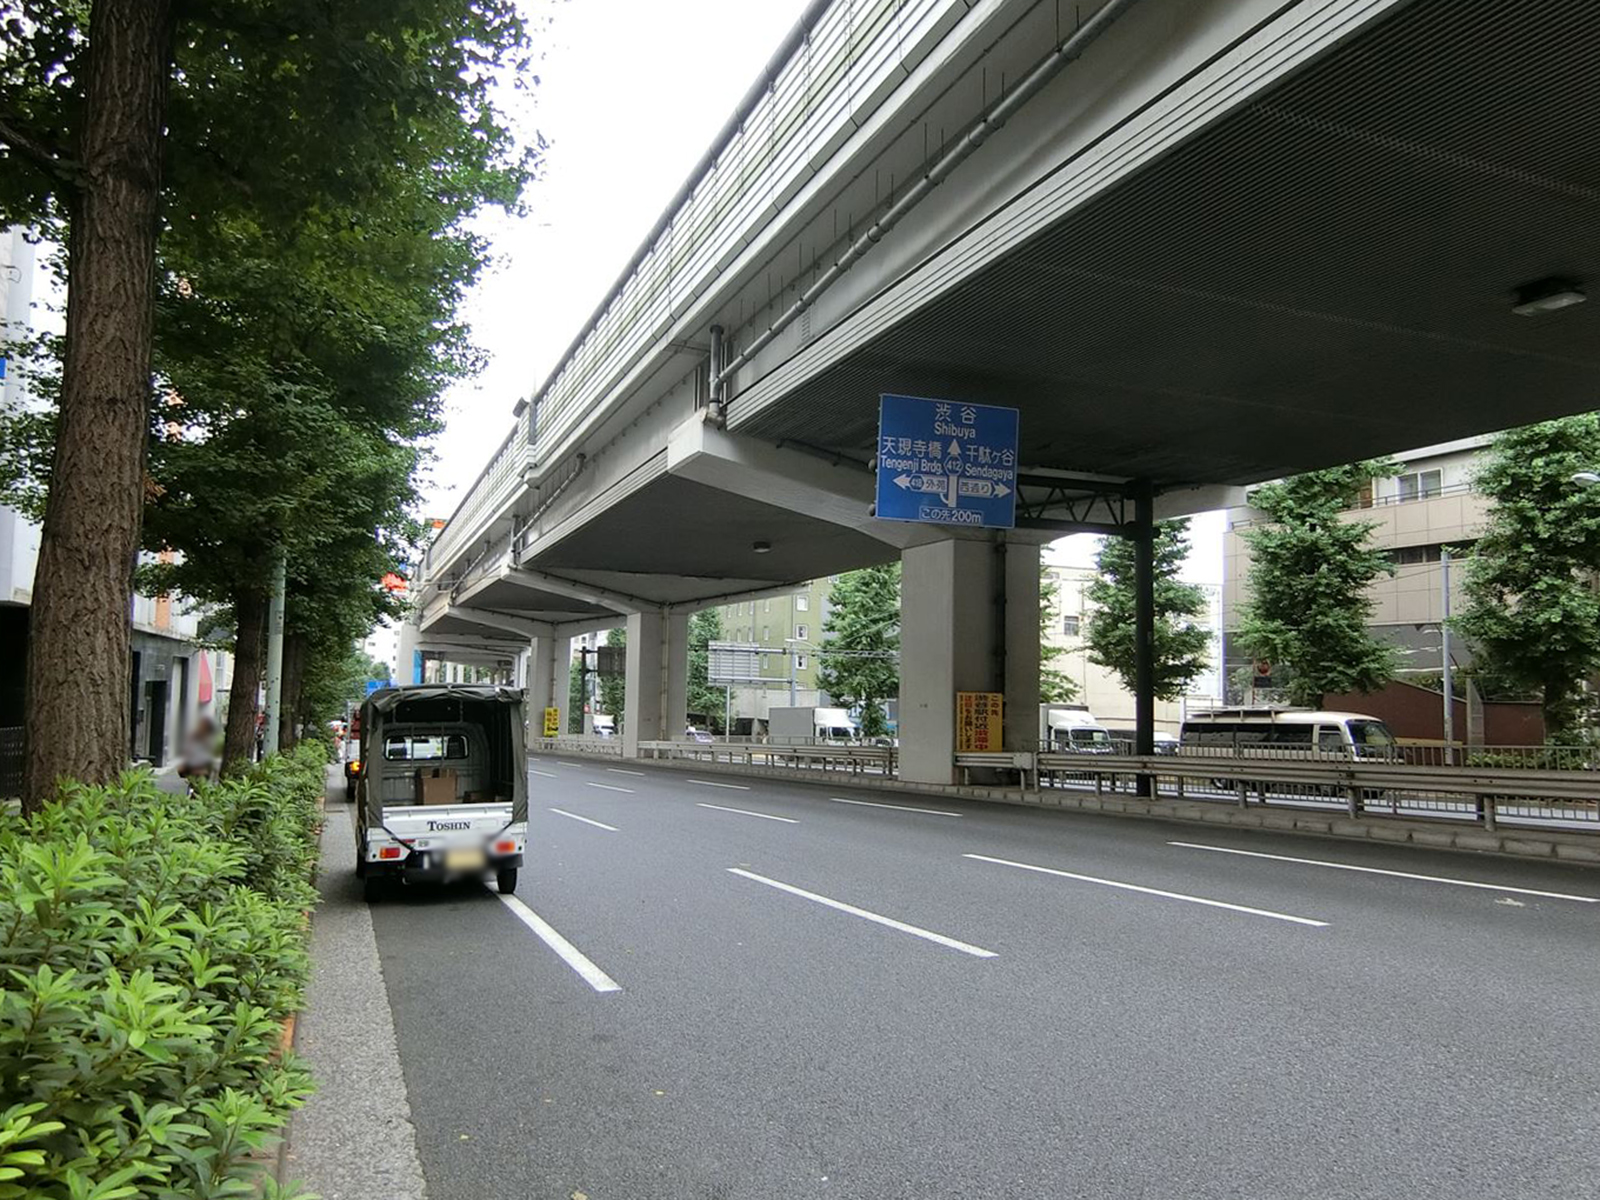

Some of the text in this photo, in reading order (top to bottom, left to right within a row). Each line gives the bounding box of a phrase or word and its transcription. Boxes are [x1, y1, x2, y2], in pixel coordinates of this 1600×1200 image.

[935, 403, 977, 425] 渋谷
[934, 422, 976, 439] Shibuya
[882, 436, 942, 460] 天現寺橋
[881, 455, 943, 474] Tengenji Brdg.
[946, 460, 961, 471] 412
[965, 463, 1014, 481] Sendagaya
